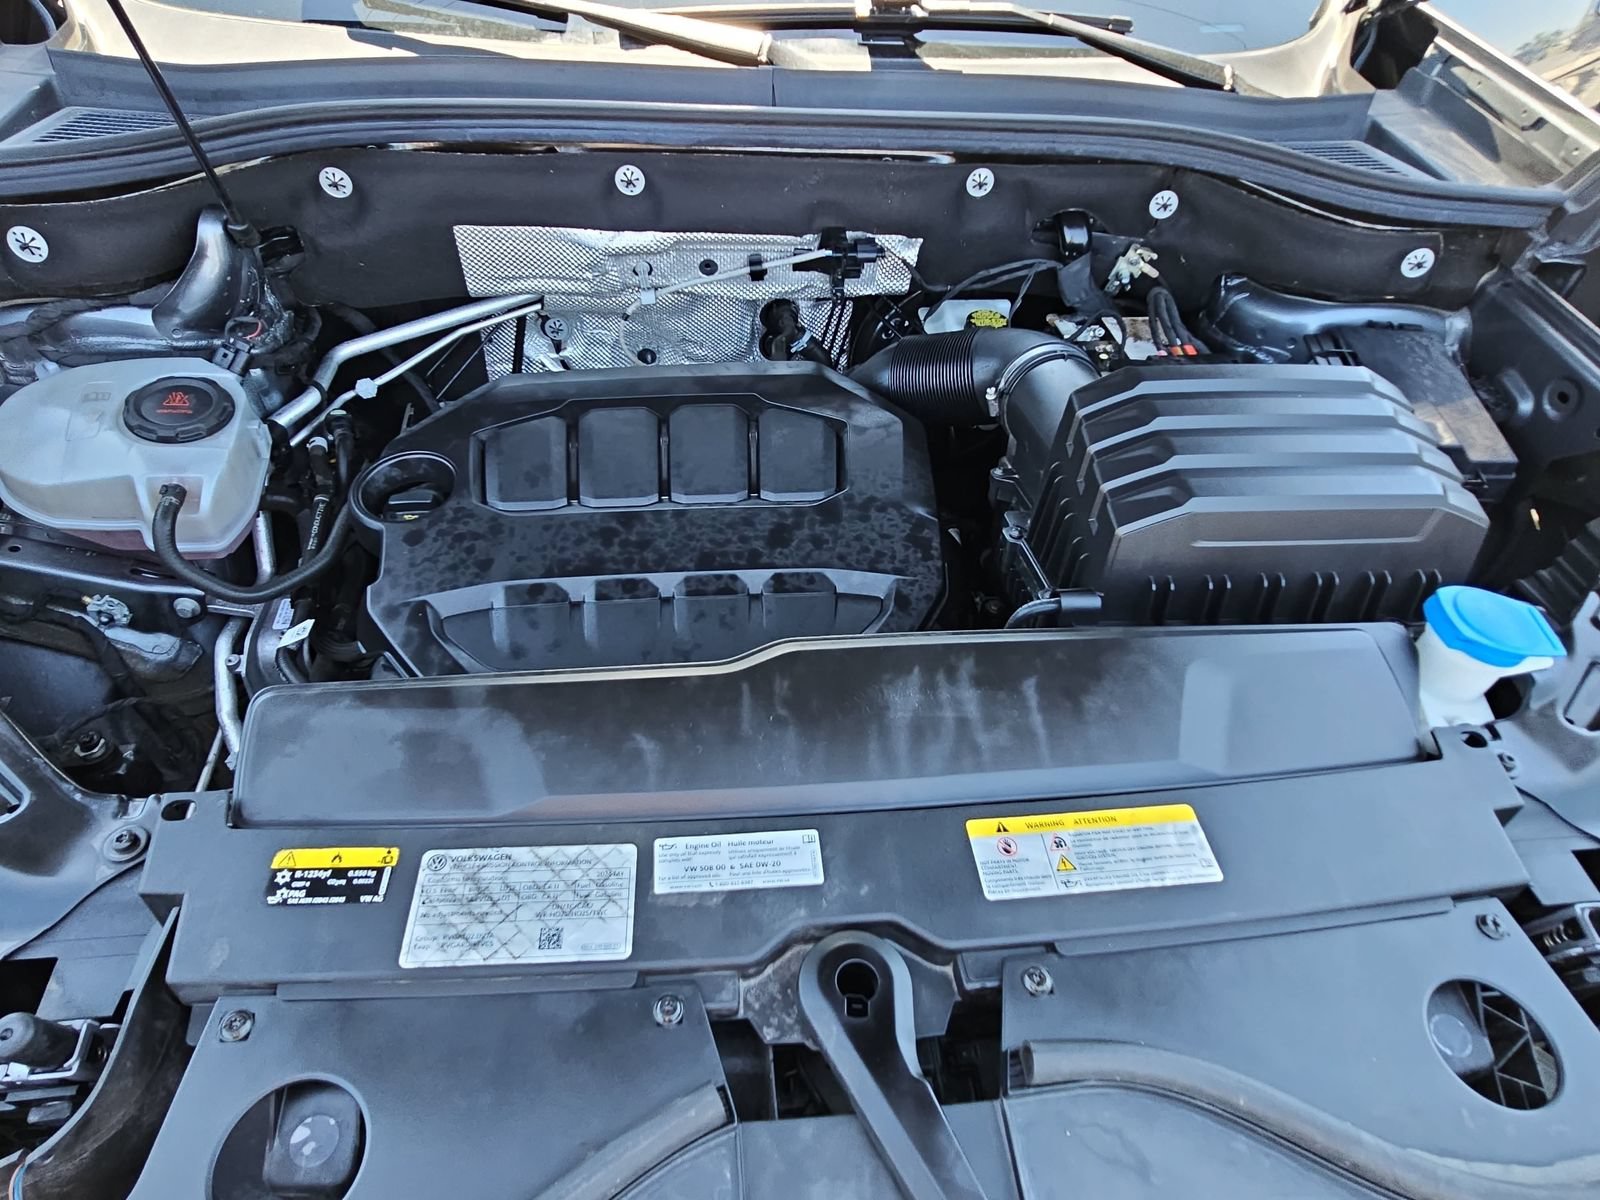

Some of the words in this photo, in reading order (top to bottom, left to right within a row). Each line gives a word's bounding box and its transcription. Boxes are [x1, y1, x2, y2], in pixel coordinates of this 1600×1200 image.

[1023, 819, 1065, 829] WARNING
[1073, 815, 1118, 825] ATTENTION
[684, 842, 709, 850] Engine
[710, 840, 722, 848] Oil
[449, 854, 512, 862] VOLKSWAGEN
